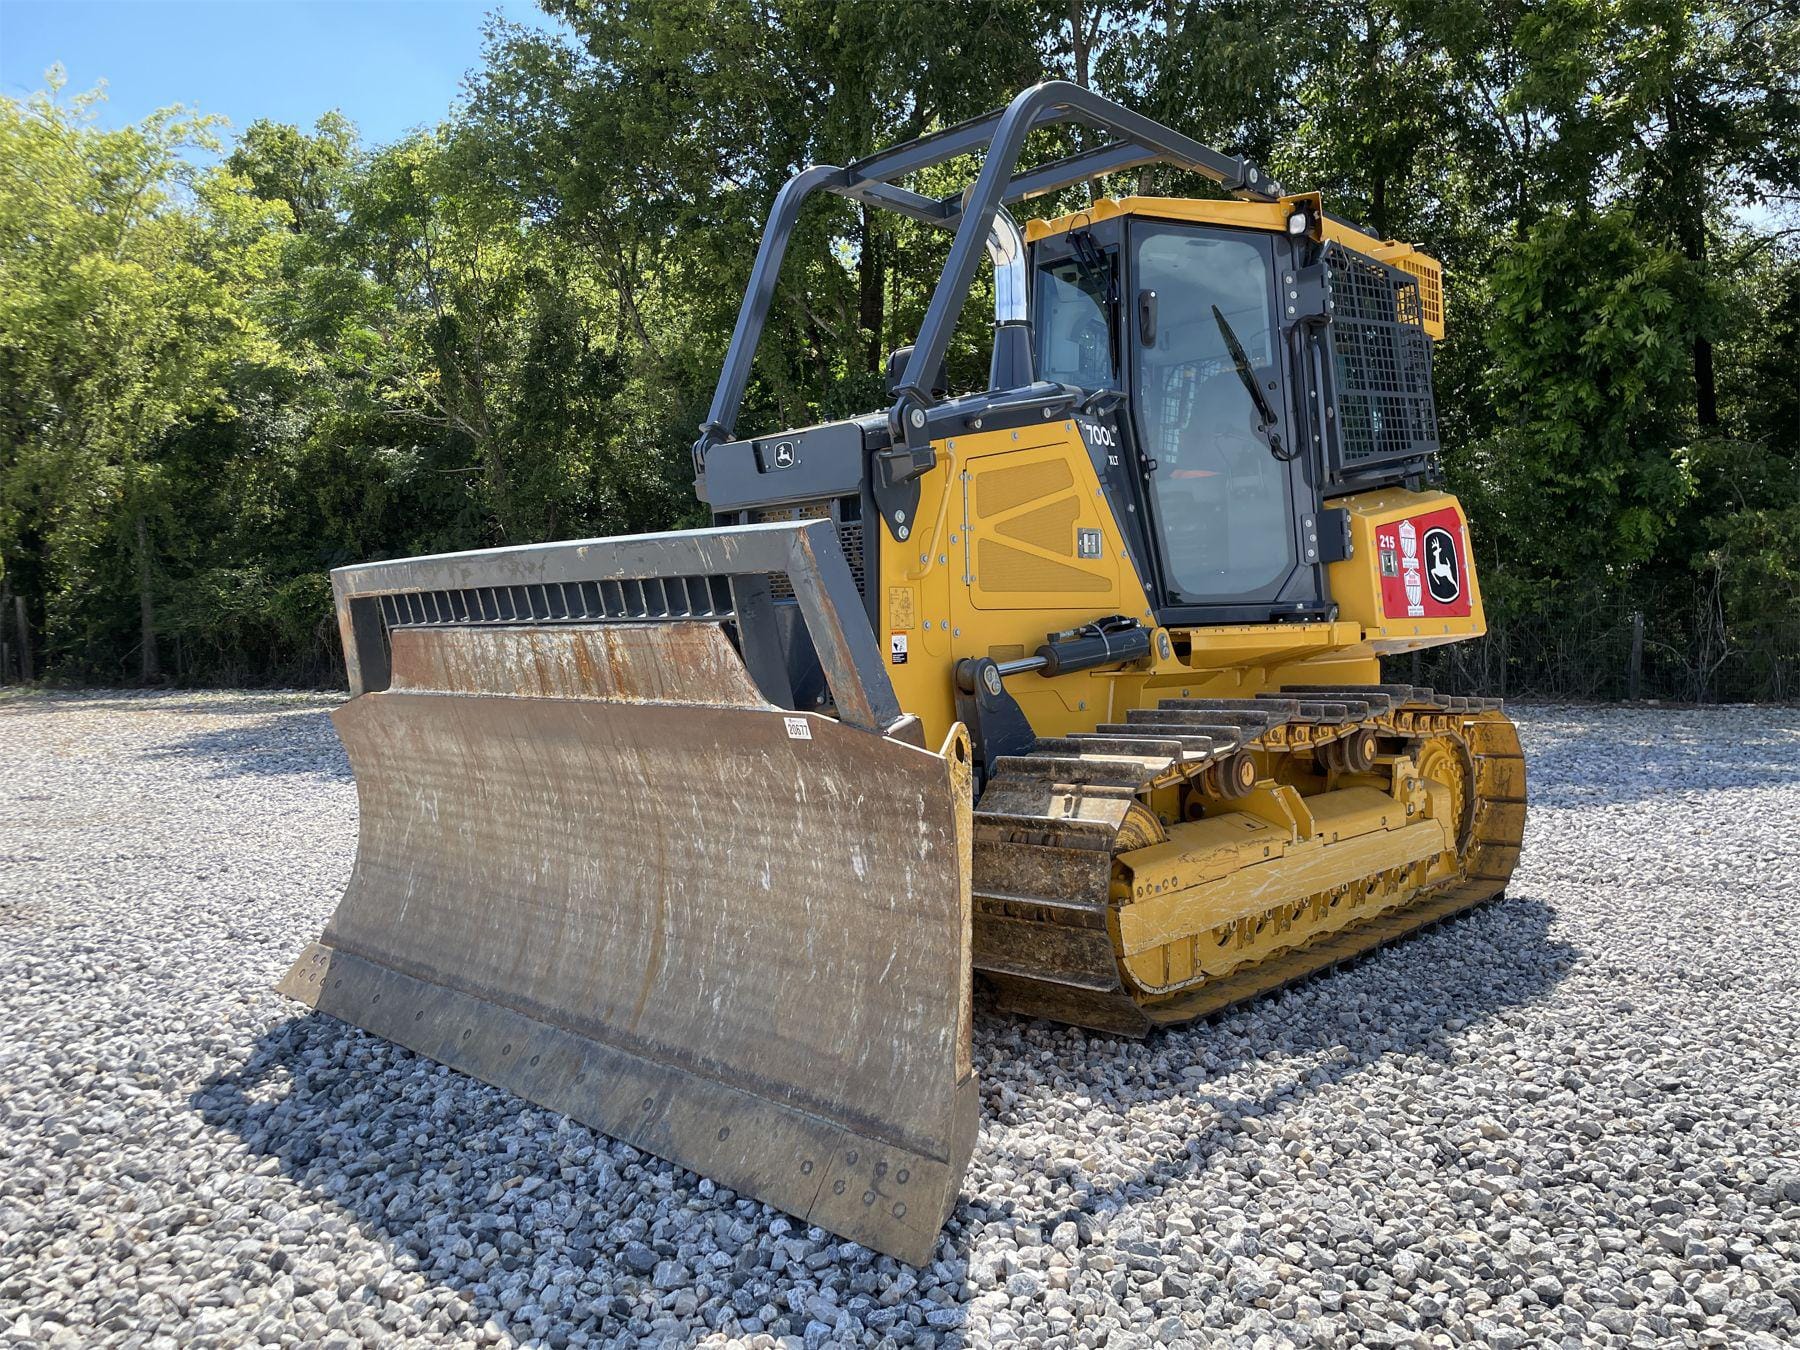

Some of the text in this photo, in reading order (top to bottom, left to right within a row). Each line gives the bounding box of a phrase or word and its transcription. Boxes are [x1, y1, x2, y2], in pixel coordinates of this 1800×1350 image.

[1085, 424, 1115, 447] 700L
[1108, 455, 1119, 466] XLT
[1379, 535, 1395, 549] 215
[787, 724, 809, 735] 20677
